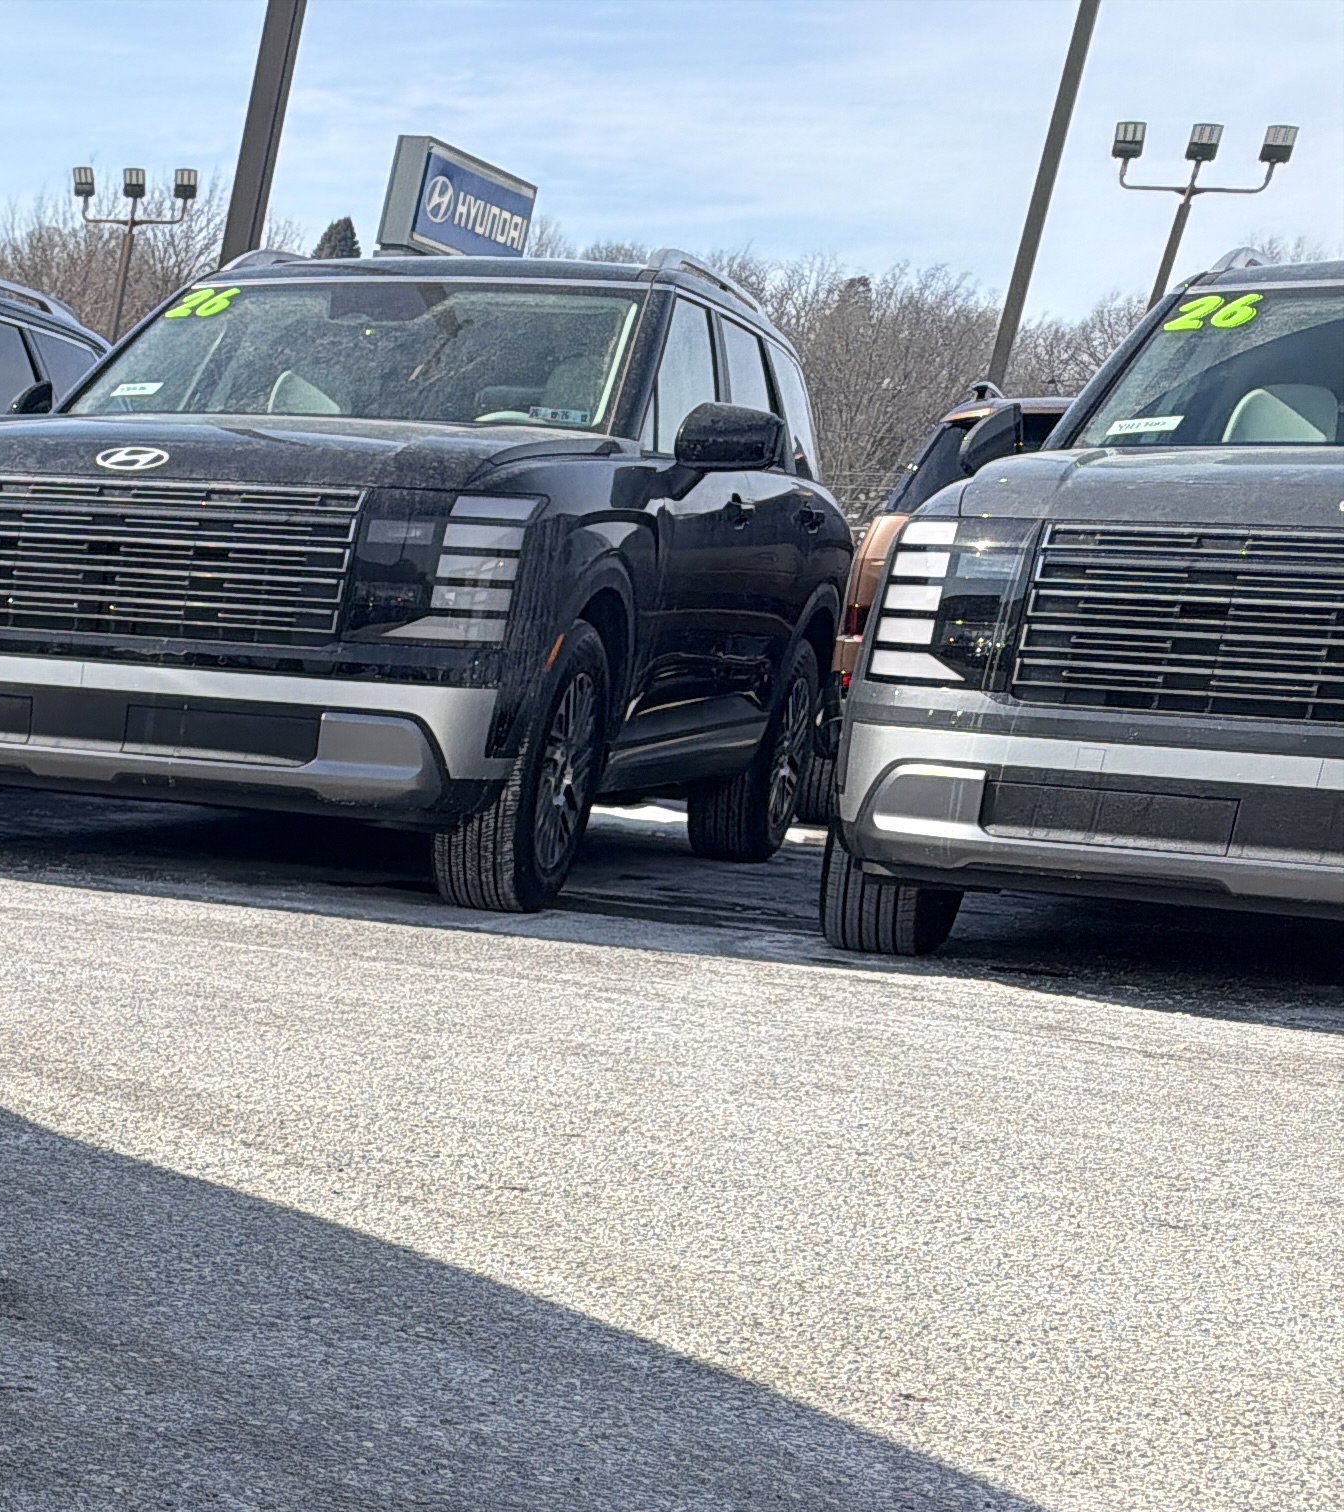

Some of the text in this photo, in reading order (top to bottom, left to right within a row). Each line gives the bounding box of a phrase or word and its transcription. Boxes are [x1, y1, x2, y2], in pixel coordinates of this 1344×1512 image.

[454, 191, 527, 250] HYUNDAI
[164, 287, 241, 318] 26
[1163, 293, 1264, 331] 26
